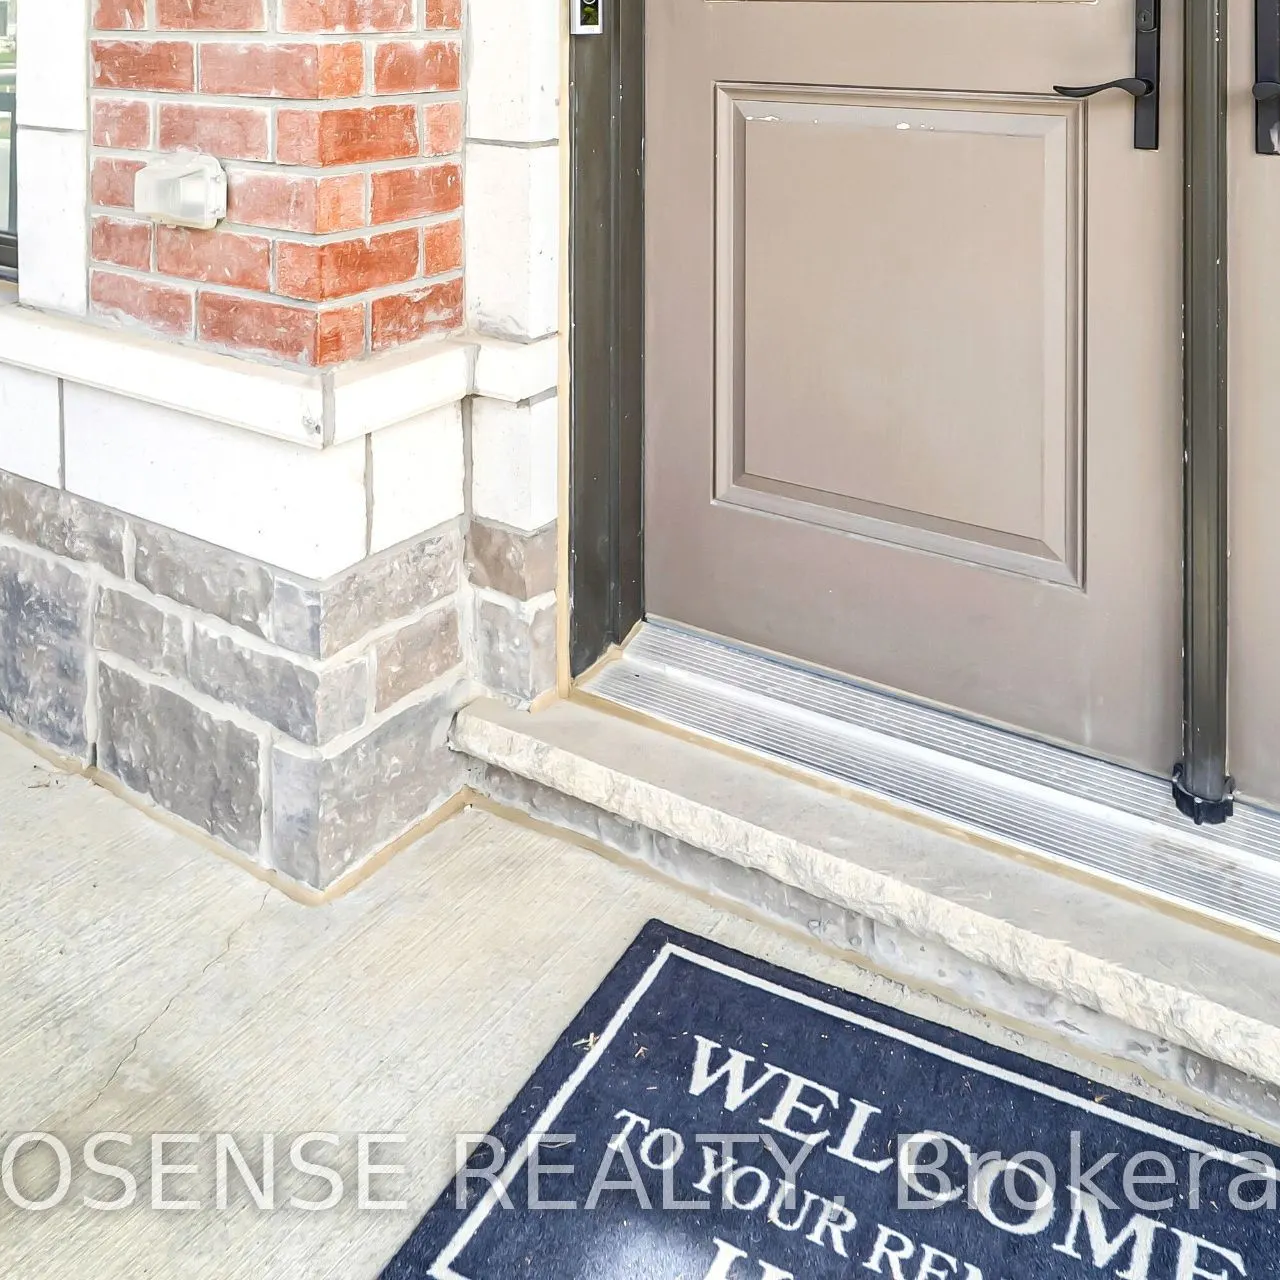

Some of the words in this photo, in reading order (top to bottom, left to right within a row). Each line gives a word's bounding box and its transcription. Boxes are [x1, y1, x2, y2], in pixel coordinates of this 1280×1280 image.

[608, 1108, 686, 1171] TO
[692, 1145, 858, 1258] YOUR
[687, 1033, 1248, 1280] WELCOME
